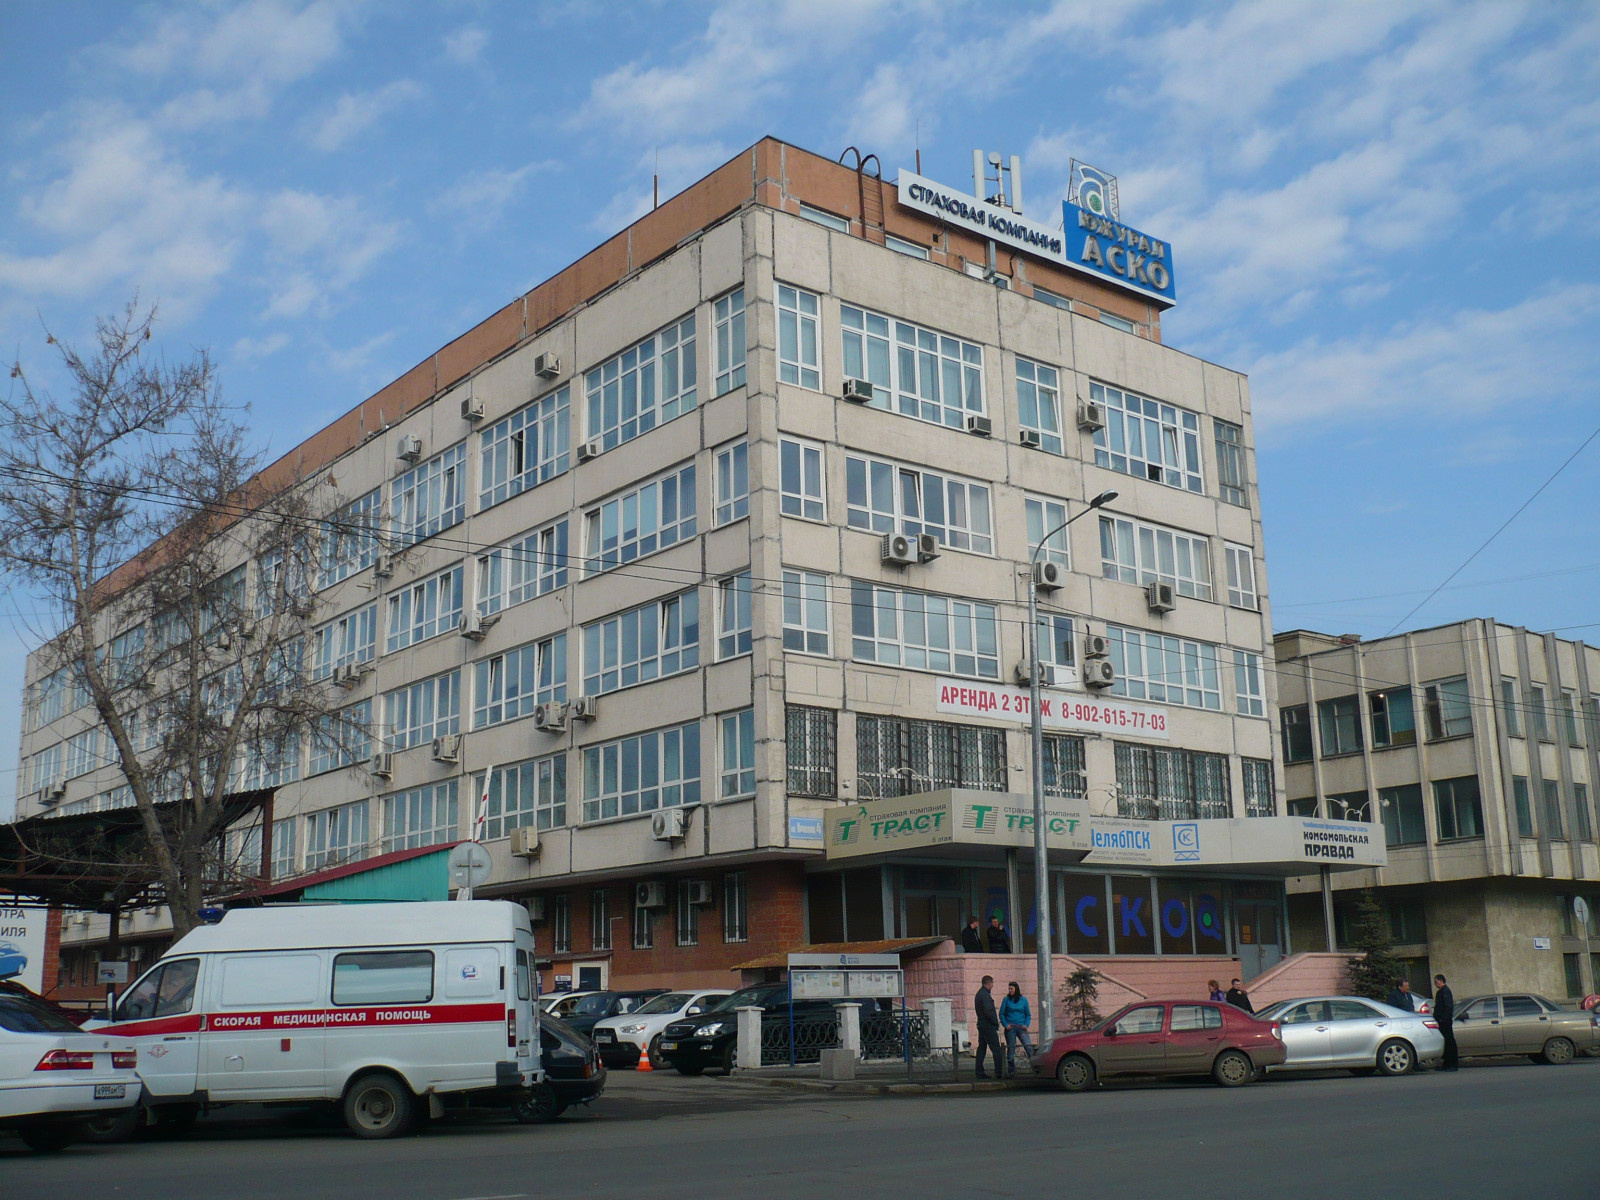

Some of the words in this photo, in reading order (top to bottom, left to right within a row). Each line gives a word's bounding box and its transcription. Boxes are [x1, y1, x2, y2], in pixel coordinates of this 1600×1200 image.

[908, 184, 985, 225] СТРАХОВАЯ
[988, 215, 1061, 254] КОМПАНИЯ
[1078, 210, 1165, 259] ЮЖУРАЛ
[1082, 235, 1170, 290] АСКО
[941, 685, 997, 712] АРЕНДА
[1002, 694, 1010, 711] 2
[1014, 696, 1052, 717] ЭТЖ
[1062, 702, 1166, 731] 8-902-615-77-03
[870, 810, 908, 822] страховая
[910, 804, 947, 815] компания
[871, 812, 946, 837] ТРАСТ
[1005, 814, 1080, 833] ТРСТ
[1303, 831, 1369, 844] КОМСОМОЛЬСКАЯ
[1304, 844, 1354, 859] ПРАВДА
[0, 908, 26, 919] ТРА
[214, 1015, 261, 1027] СКОРАЯ
[273, 1011, 367, 1025] МЕДИЦИНСКАЯ
[376, 1009, 432, 1021] ПОМОЩЬ
